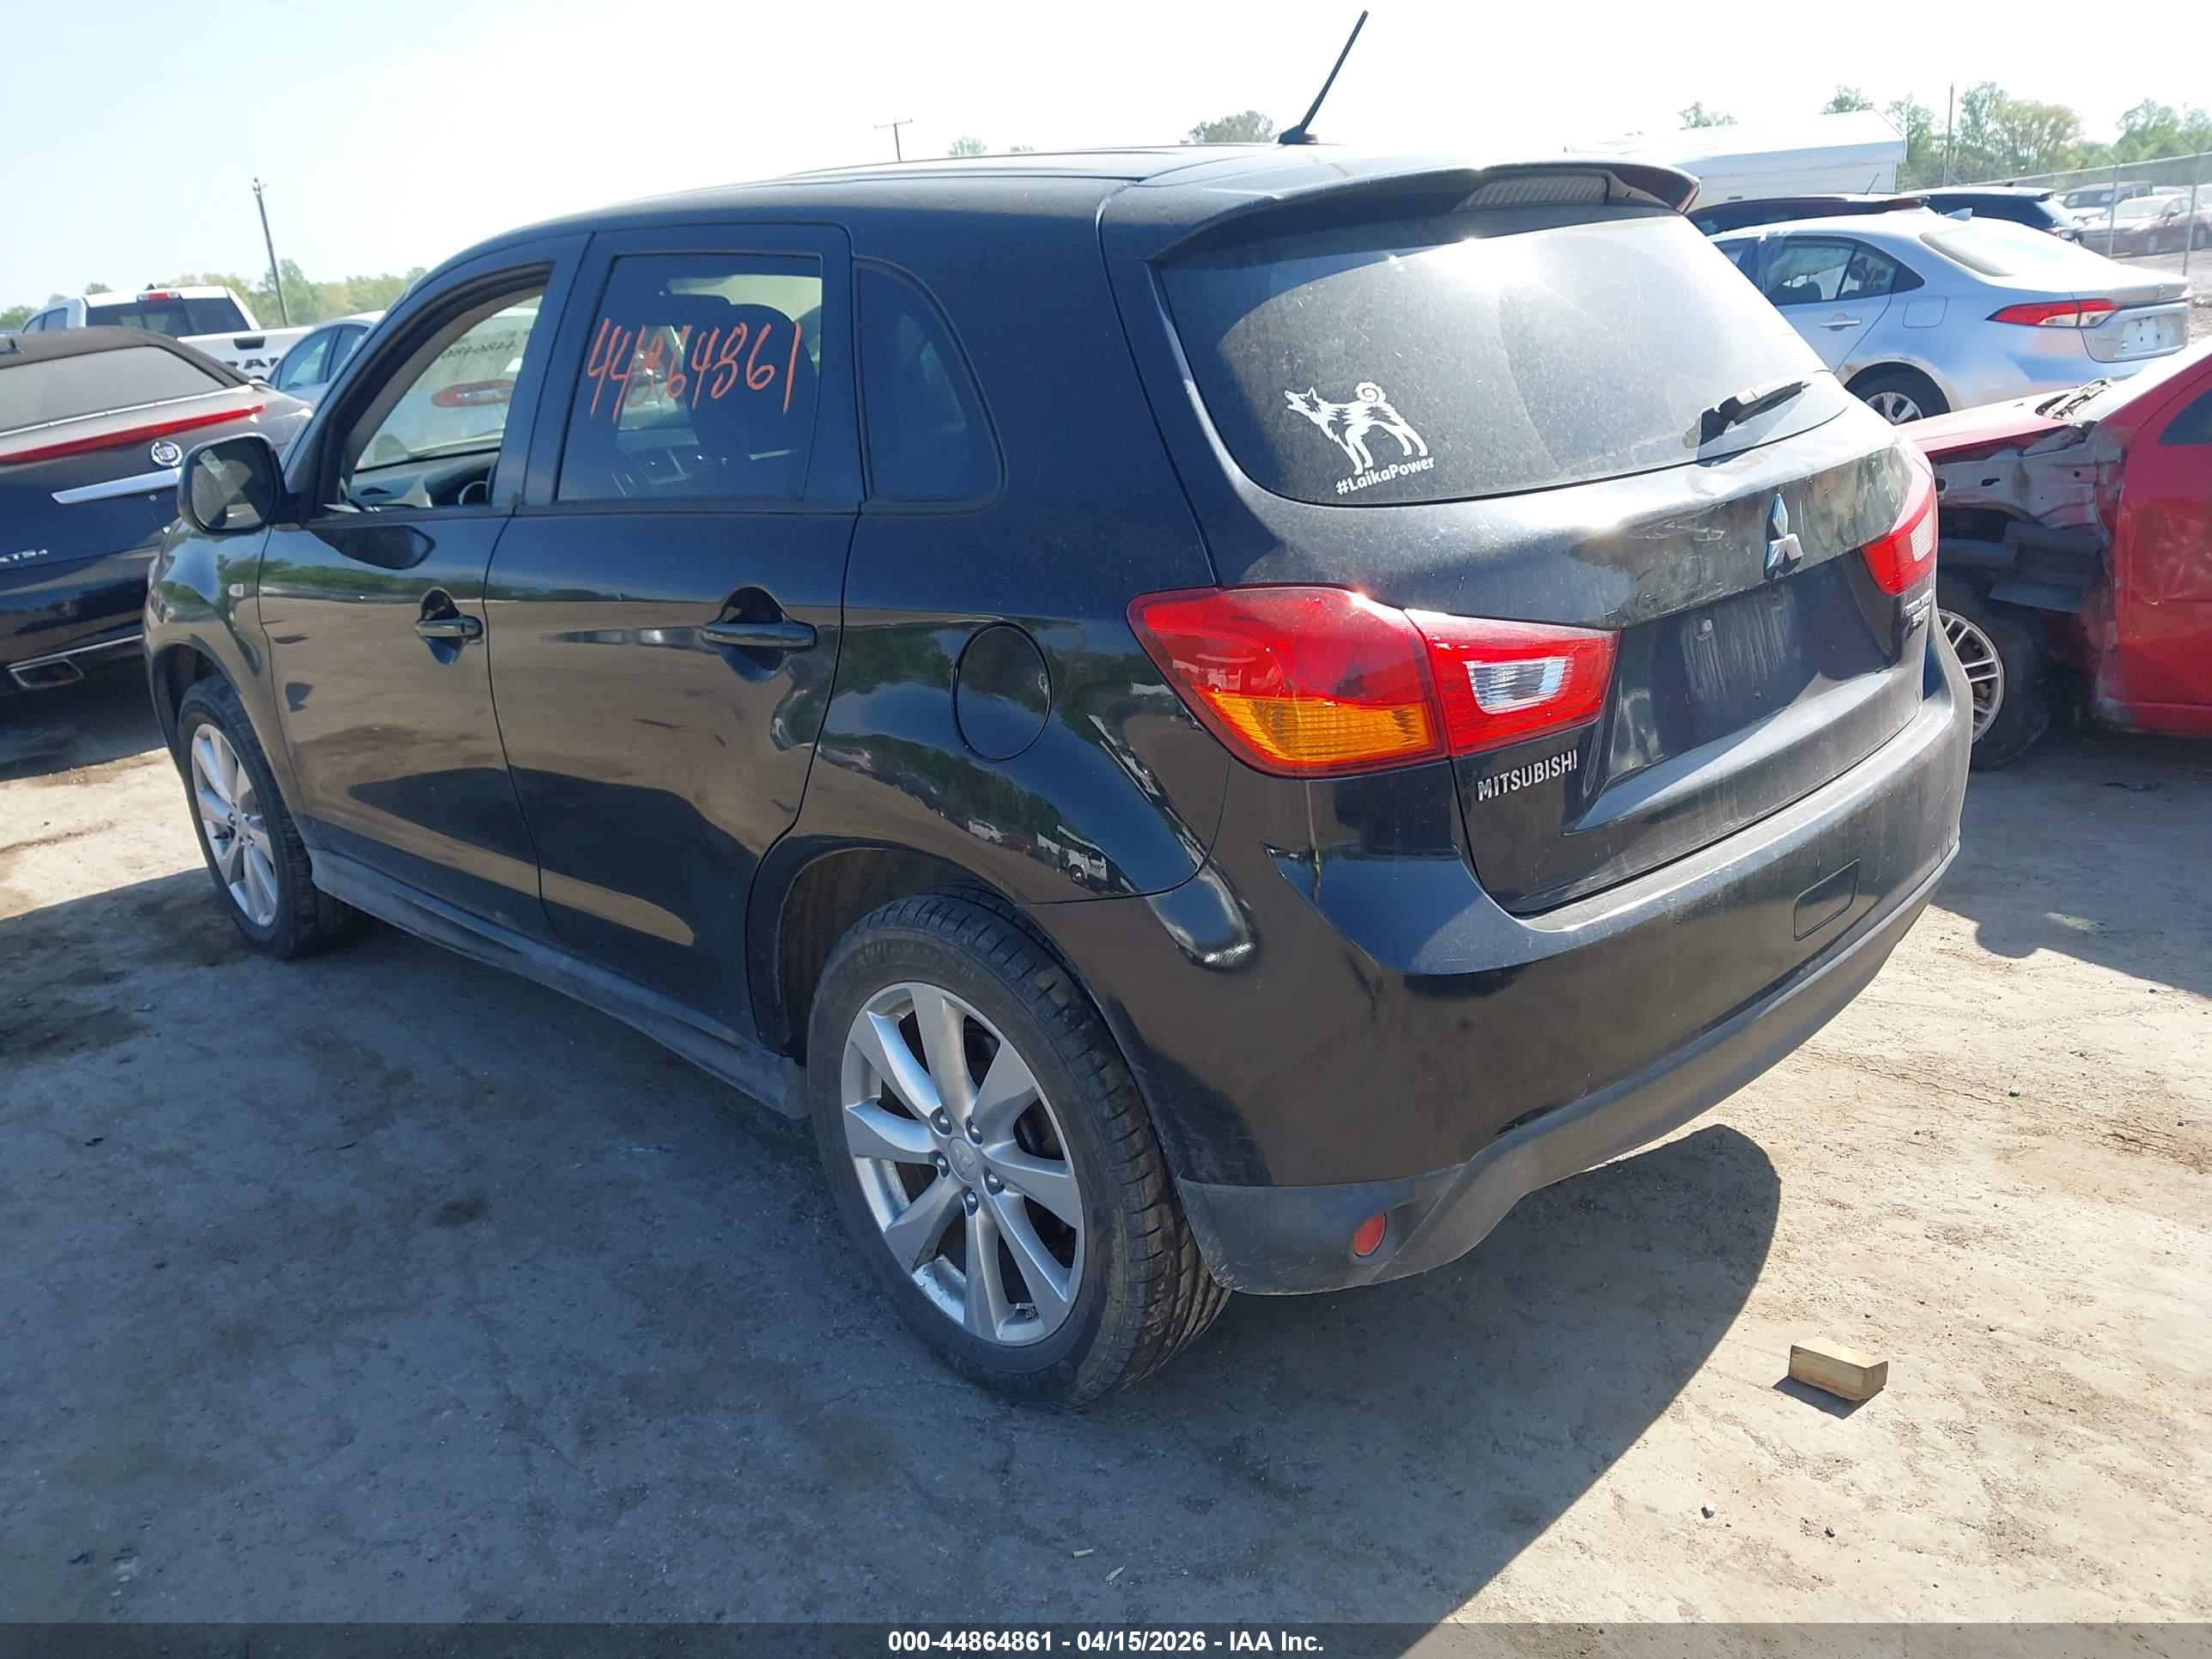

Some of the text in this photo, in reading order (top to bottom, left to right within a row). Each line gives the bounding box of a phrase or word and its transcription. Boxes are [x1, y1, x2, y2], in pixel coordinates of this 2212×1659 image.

[587, 318, 801, 424] 44864861
[1335, 457, 1435, 495] #LaikaPower
[1477, 749, 1578, 802] MITSUBISHI
